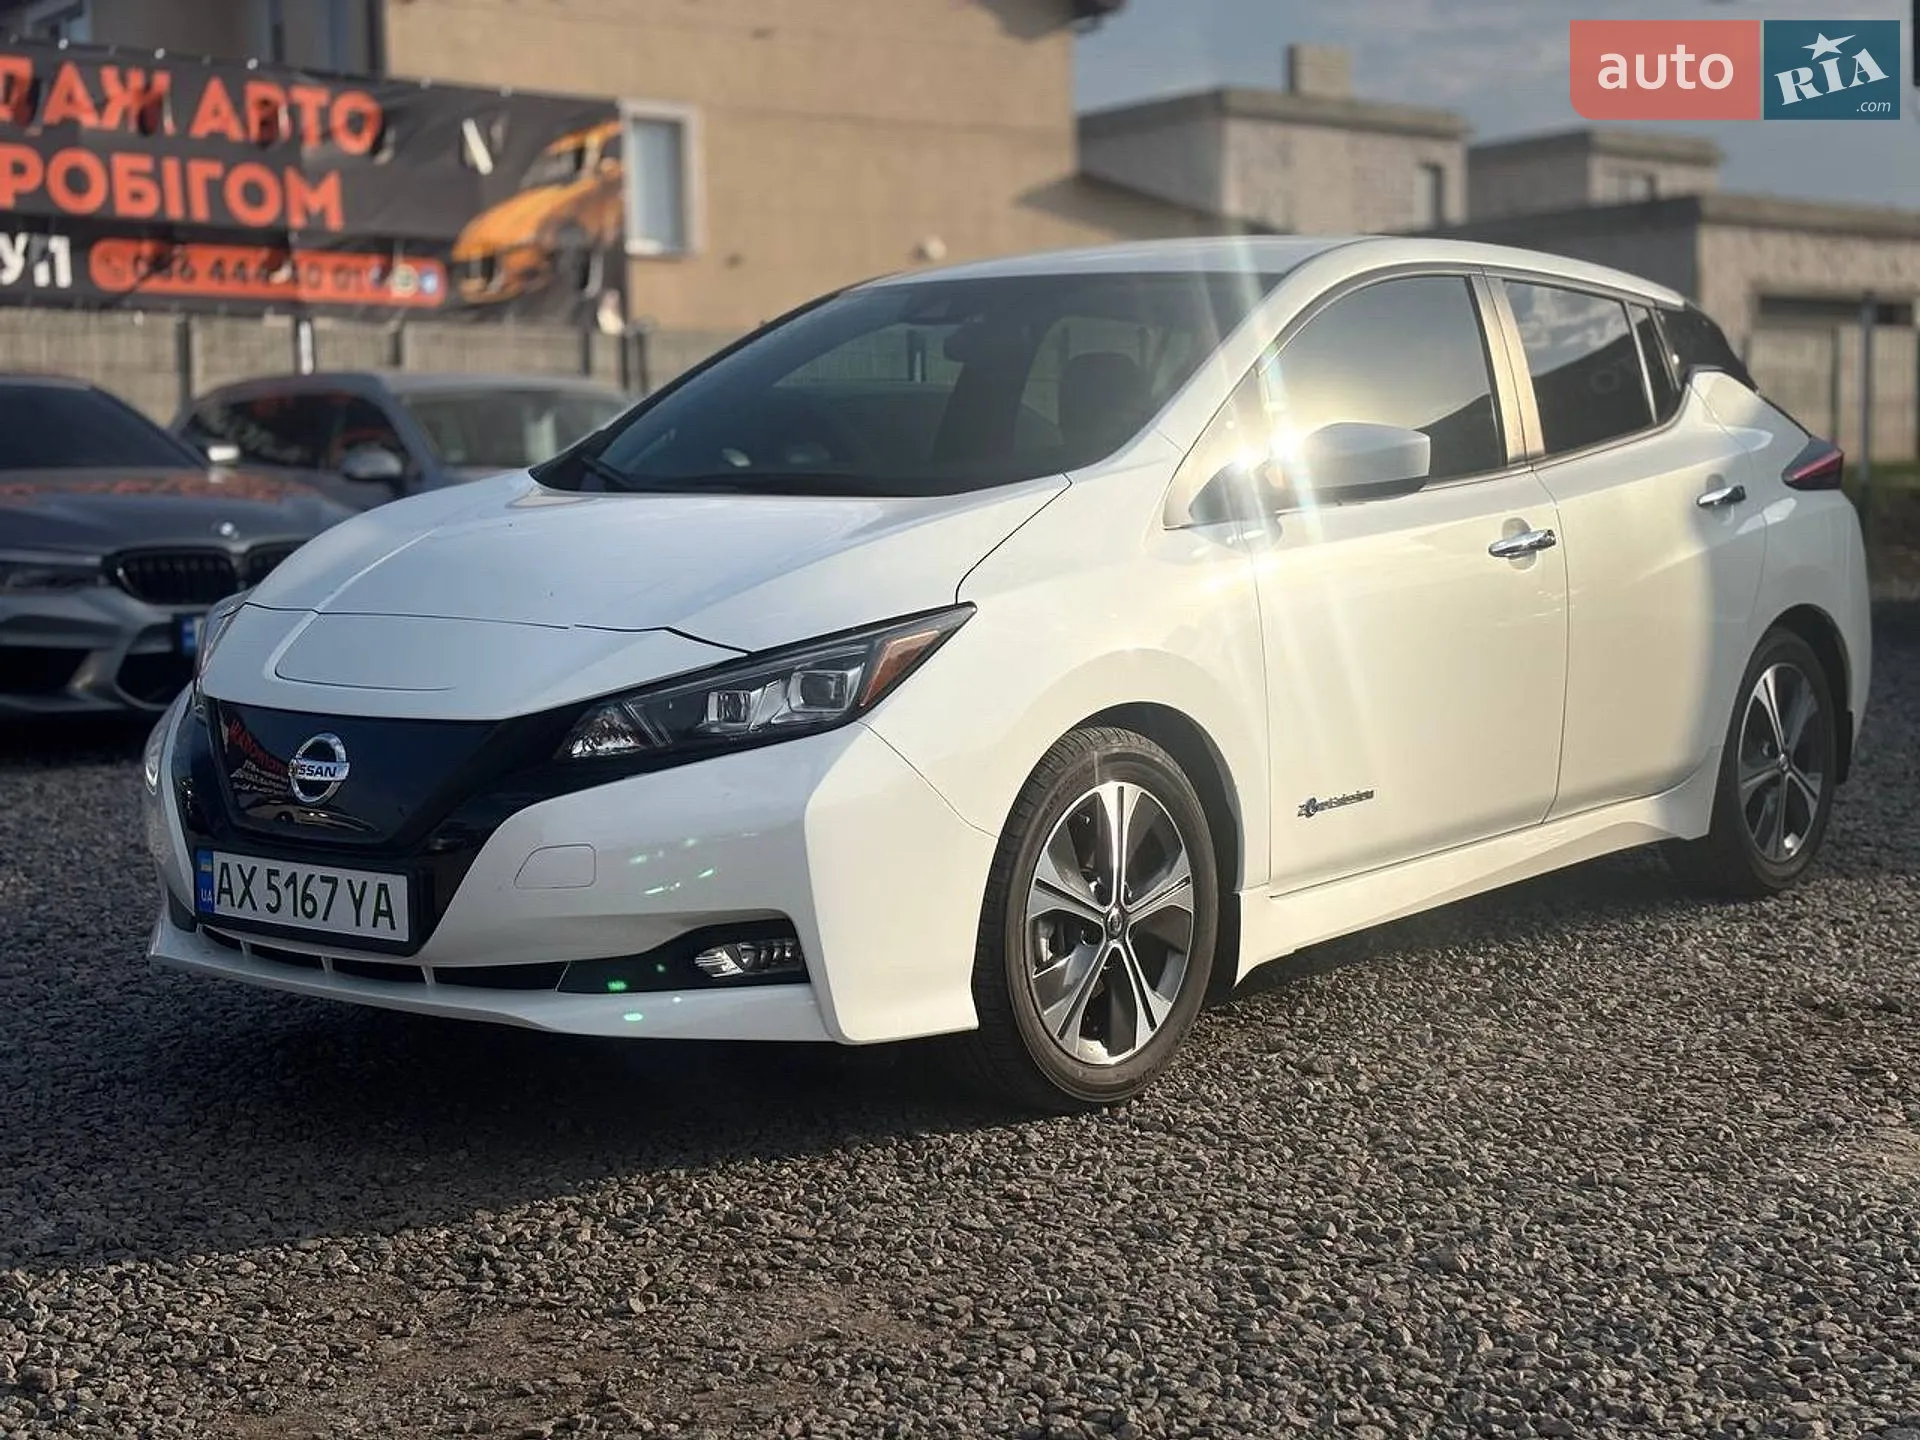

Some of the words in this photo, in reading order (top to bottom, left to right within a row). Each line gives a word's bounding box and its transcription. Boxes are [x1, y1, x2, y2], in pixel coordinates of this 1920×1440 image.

[0, 141, 343, 232] РОБІГОМ
[289, 762, 337, 778] SSAN
[200, 888, 213, 903] UA
[216, 862, 257, 911] AX
[265, 868, 338, 921] 5167
[347, 879, 396, 930] YA
